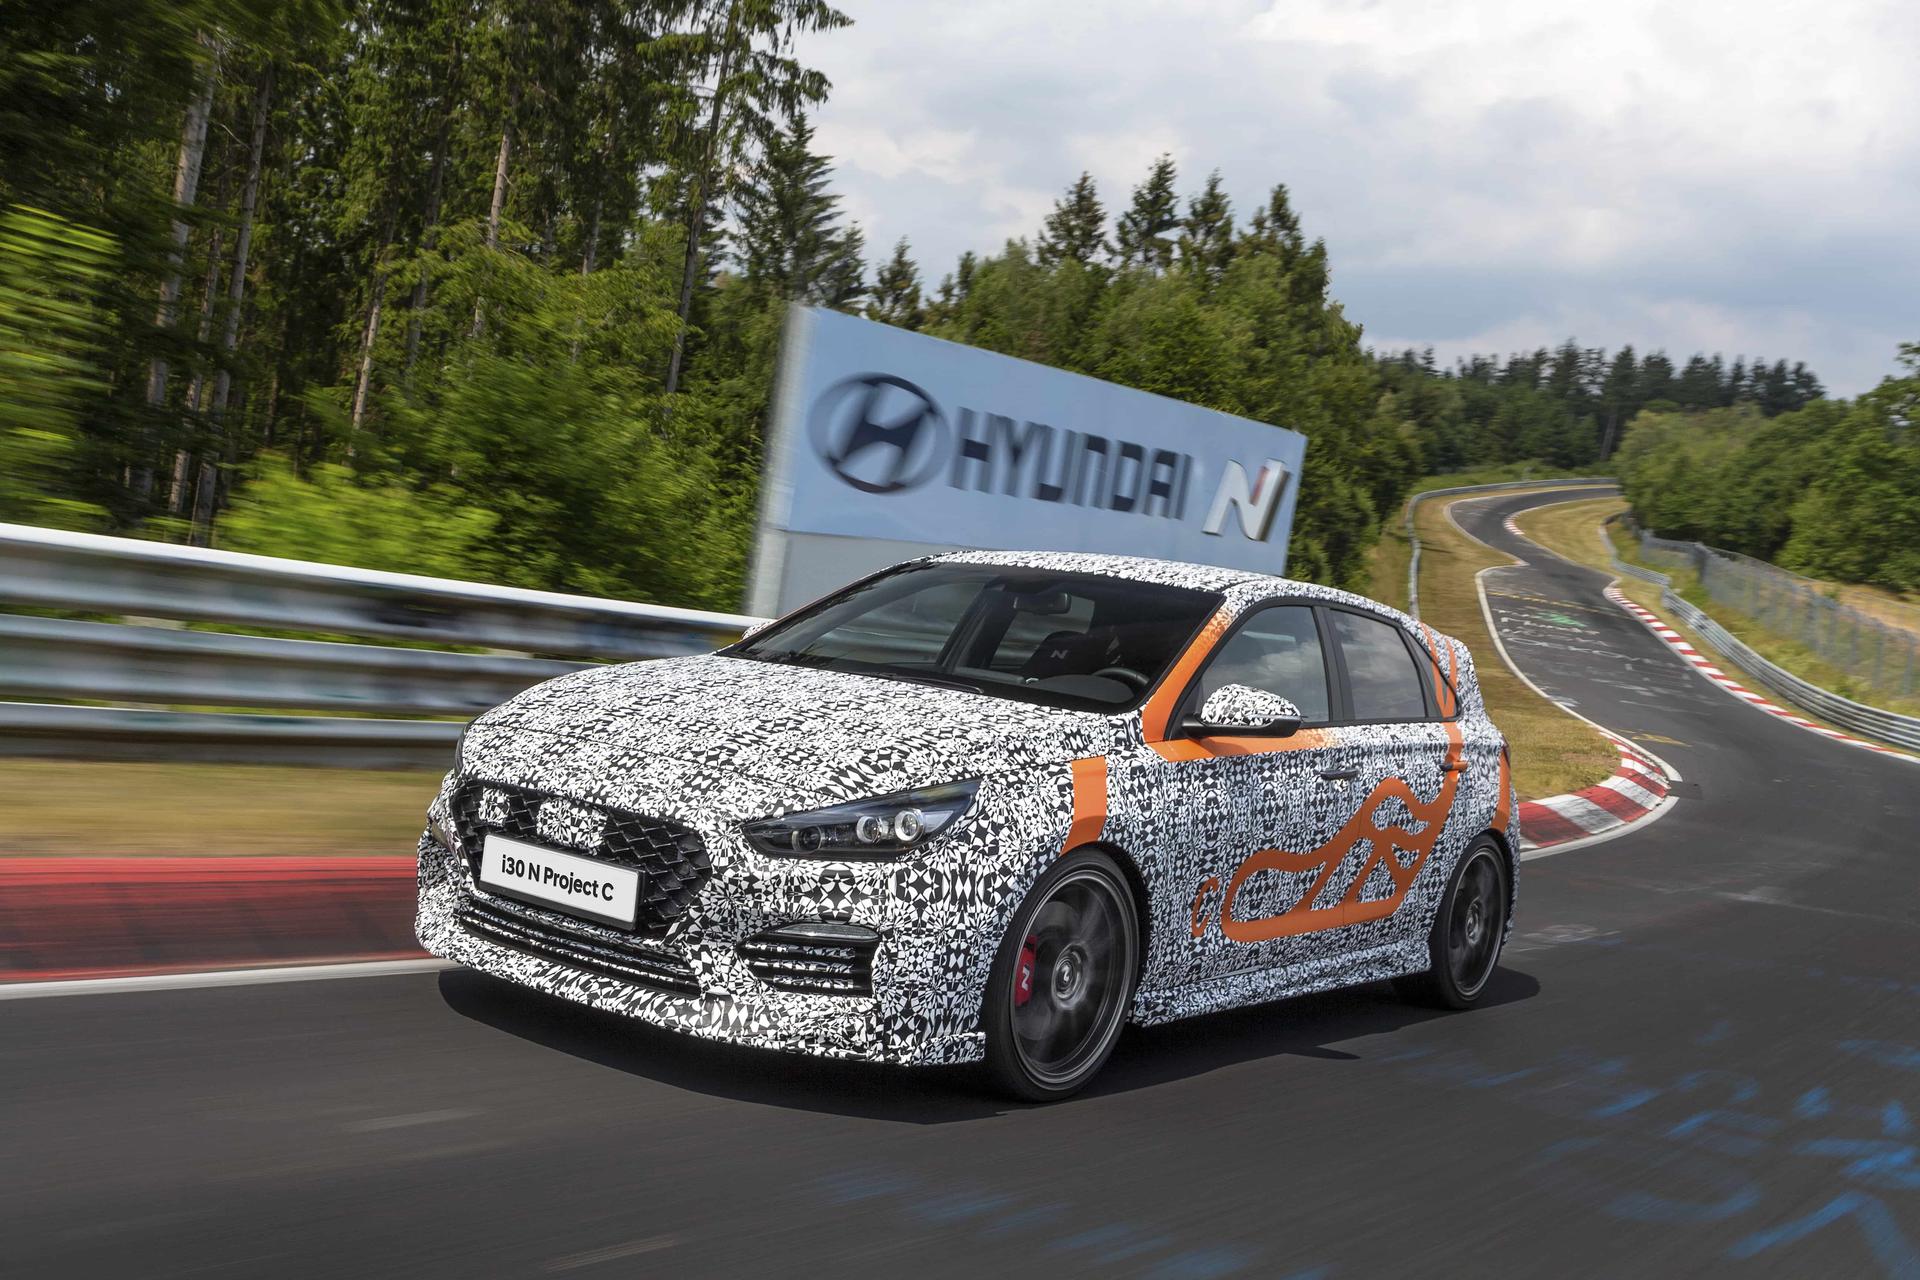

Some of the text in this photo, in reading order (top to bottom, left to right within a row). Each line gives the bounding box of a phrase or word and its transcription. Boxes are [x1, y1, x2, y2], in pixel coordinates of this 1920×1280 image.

[948, 406, 1290, 542] HYUNDAI N
[501, 854, 614, 900] i30 N Project C
